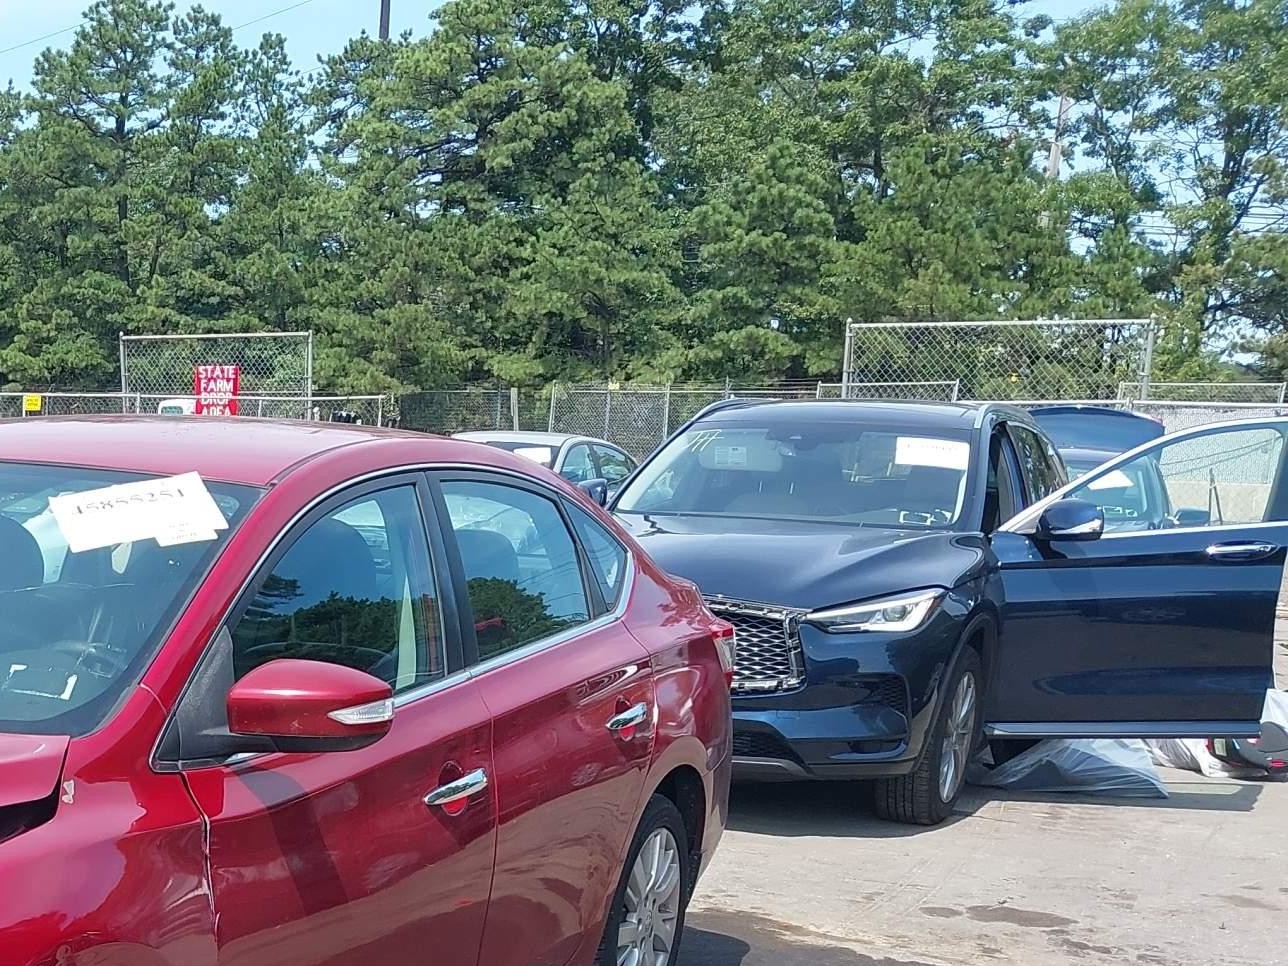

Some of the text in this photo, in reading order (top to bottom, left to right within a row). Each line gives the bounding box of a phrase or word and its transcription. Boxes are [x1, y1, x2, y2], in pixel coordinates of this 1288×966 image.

[198, 366, 236, 378] STATE
[200, 379, 234, 392] FARM
[201, 391, 233, 405] DROP
